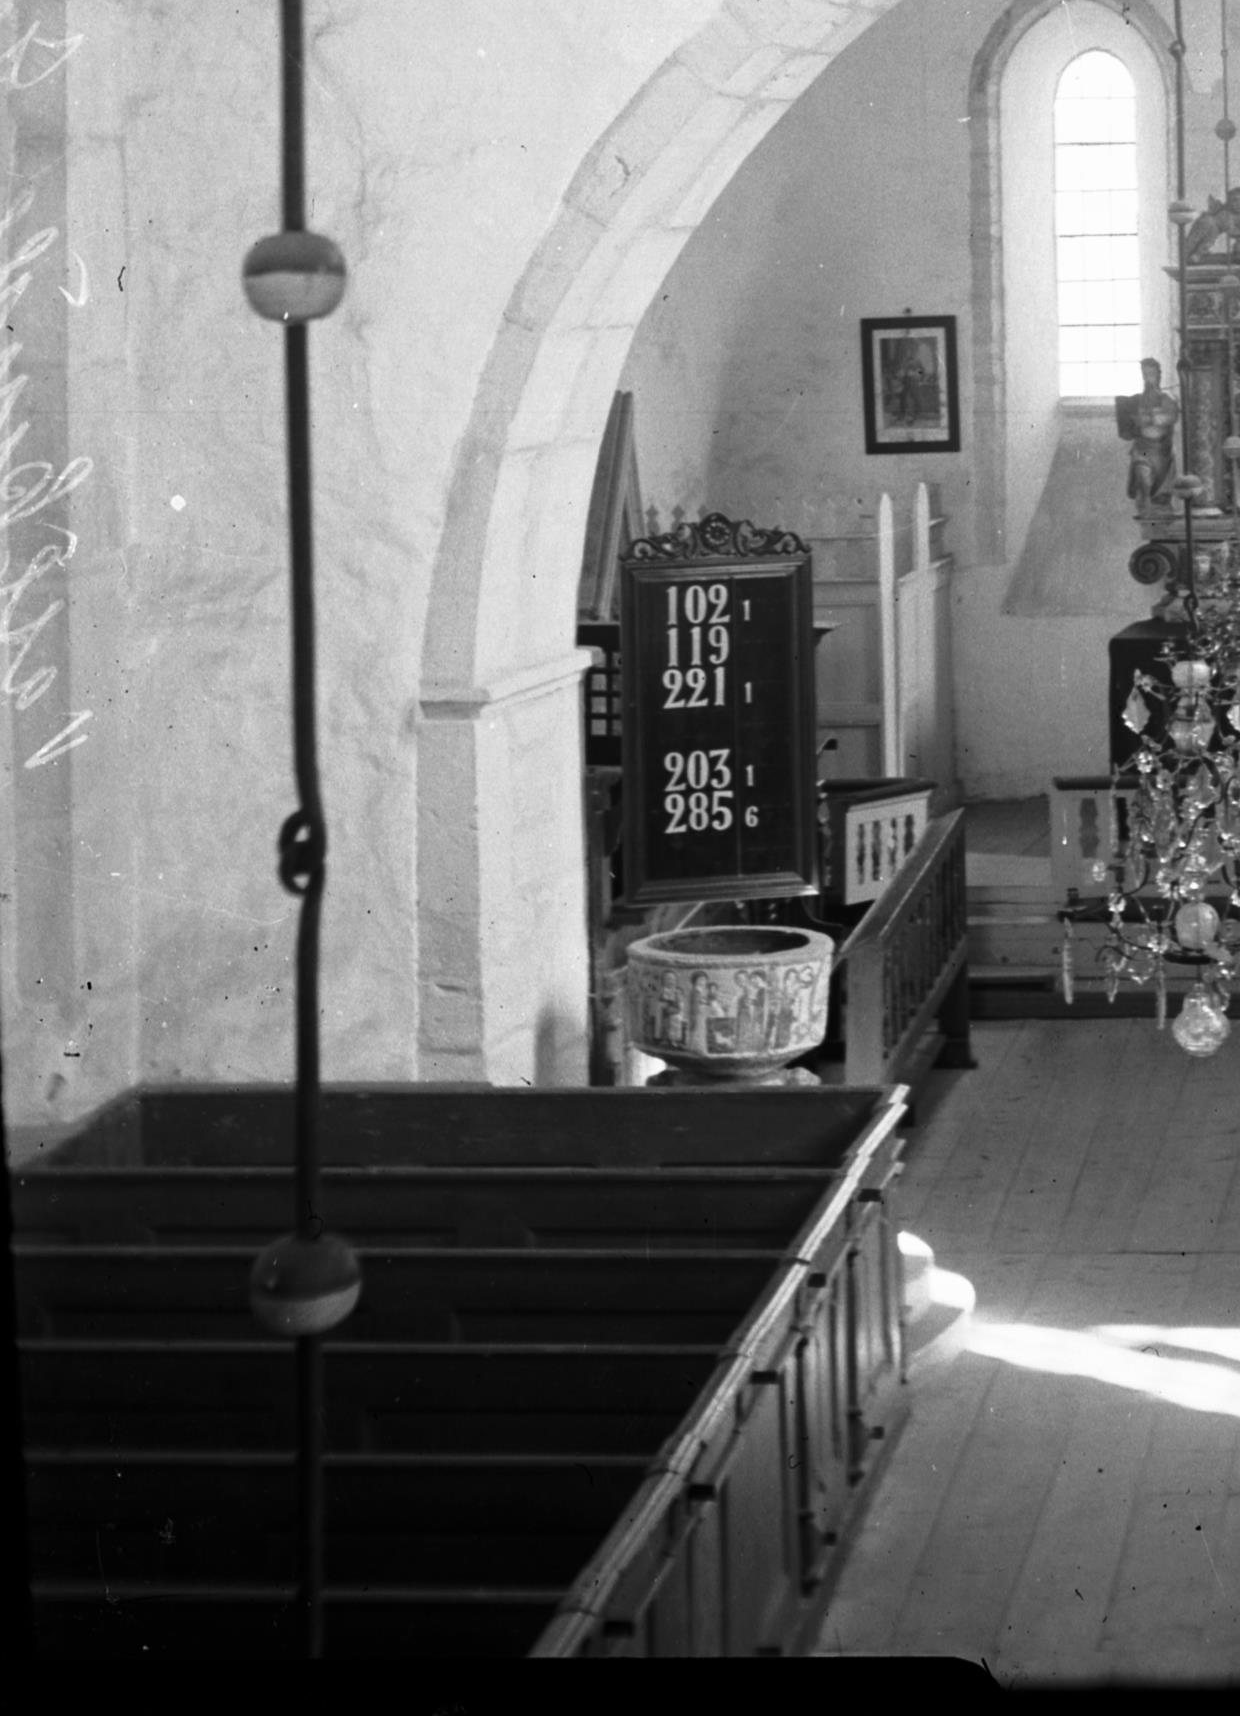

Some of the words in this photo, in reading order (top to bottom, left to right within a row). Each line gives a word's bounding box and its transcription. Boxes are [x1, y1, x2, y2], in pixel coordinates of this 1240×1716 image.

[666, 583, 731, 625] 102
[742, 598, 751, 622] 1
[666, 625, 730, 667] 119
[662, 666, 726, 709] 221
[744, 680, 753, 704] 1
[664, 748, 732, 792] 203
[746, 764, 755, 787] 1
[664, 790, 735, 834] 285
[744, 805, 760, 828] 6
